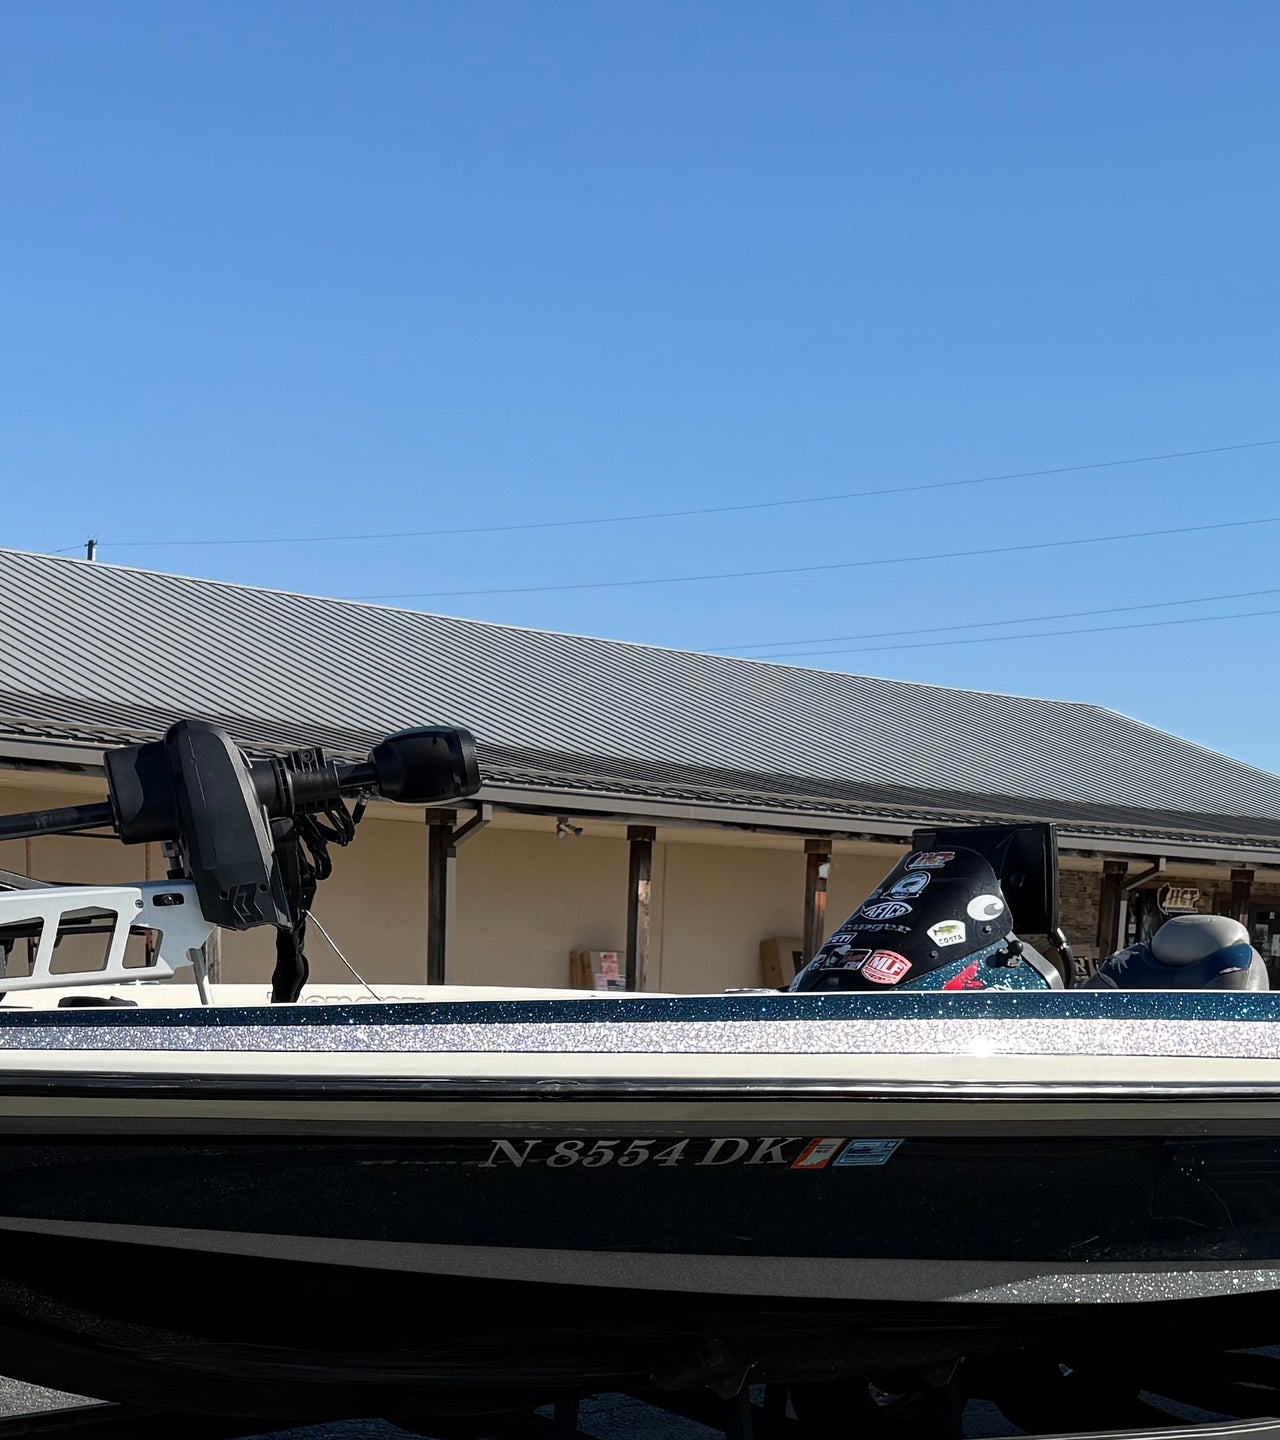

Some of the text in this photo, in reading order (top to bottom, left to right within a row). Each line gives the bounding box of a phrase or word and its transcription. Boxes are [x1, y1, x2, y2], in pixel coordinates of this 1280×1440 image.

[872, 956, 905, 975] MLF
[546, 1138, 690, 1168] 8554
[694, 1137, 803, 1166] DK
